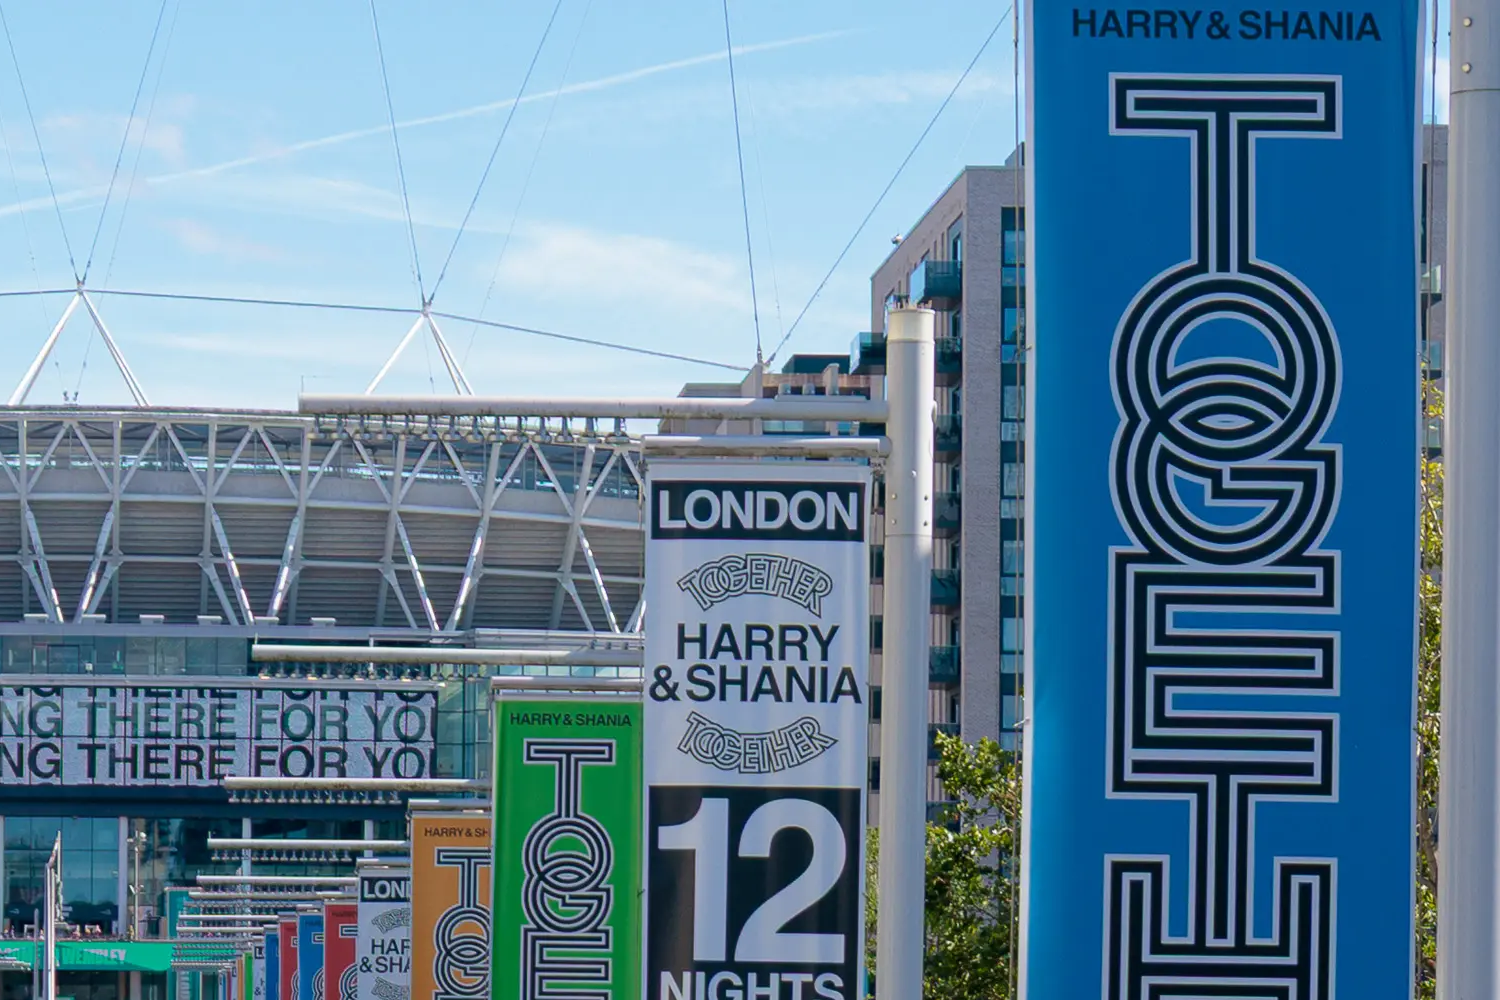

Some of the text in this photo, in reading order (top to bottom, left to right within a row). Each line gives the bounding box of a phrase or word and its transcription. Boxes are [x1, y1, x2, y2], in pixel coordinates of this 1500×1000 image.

[1072, 8, 1202, 39] HARRY
[1238, 10, 1382, 41] SHANIA
[658, 489, 858, 531] LONDON
[677, 553, 833, 618] TOGETHER
[677, 623, 839, 661] HARRY
[77, 701, 236, 740] THERE
[254, 703, 348, 743] FOR
[363, 704, 437, 744] YO
[510, 713, 562, 726] HARRY
[576, 714, 632, 727] SHANIA
[77, 743, 235, 780] THERE
[254, 745, 348, 778] FOR
[362, 746, 437, 778] YO
[677, 711, 838, 774] TOGETHER
[424, 827, 464, 838] HARRY
[658, 797, 847, 964] 12
